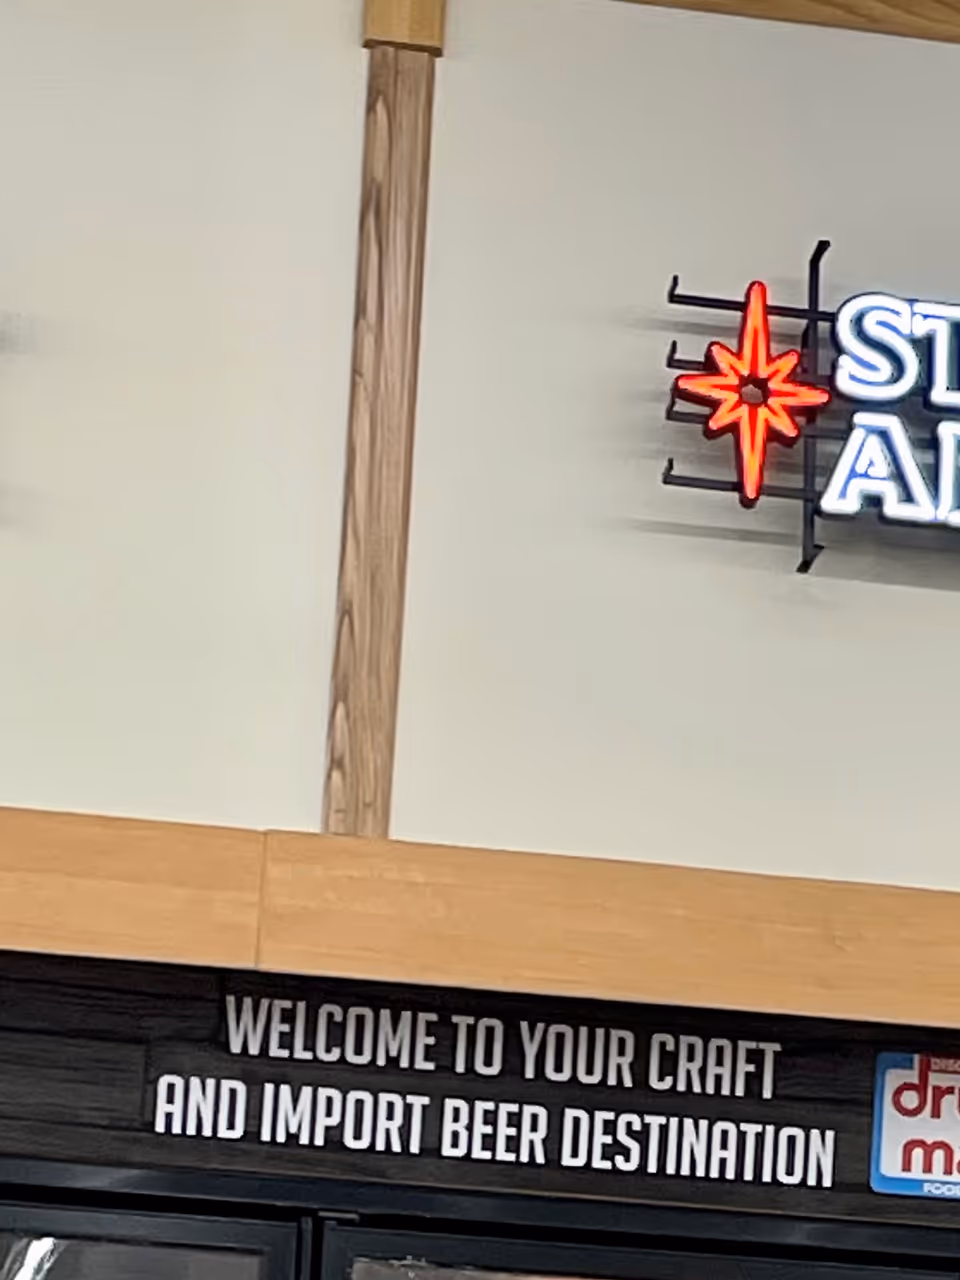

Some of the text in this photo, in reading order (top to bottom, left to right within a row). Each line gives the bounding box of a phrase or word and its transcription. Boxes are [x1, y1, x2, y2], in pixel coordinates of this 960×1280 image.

[226, 996, 781, 1099] WELCOME TO YOUR CRAFT
[154, 1074, 835, 1188] AND IMPORT BEER DESTINATION
